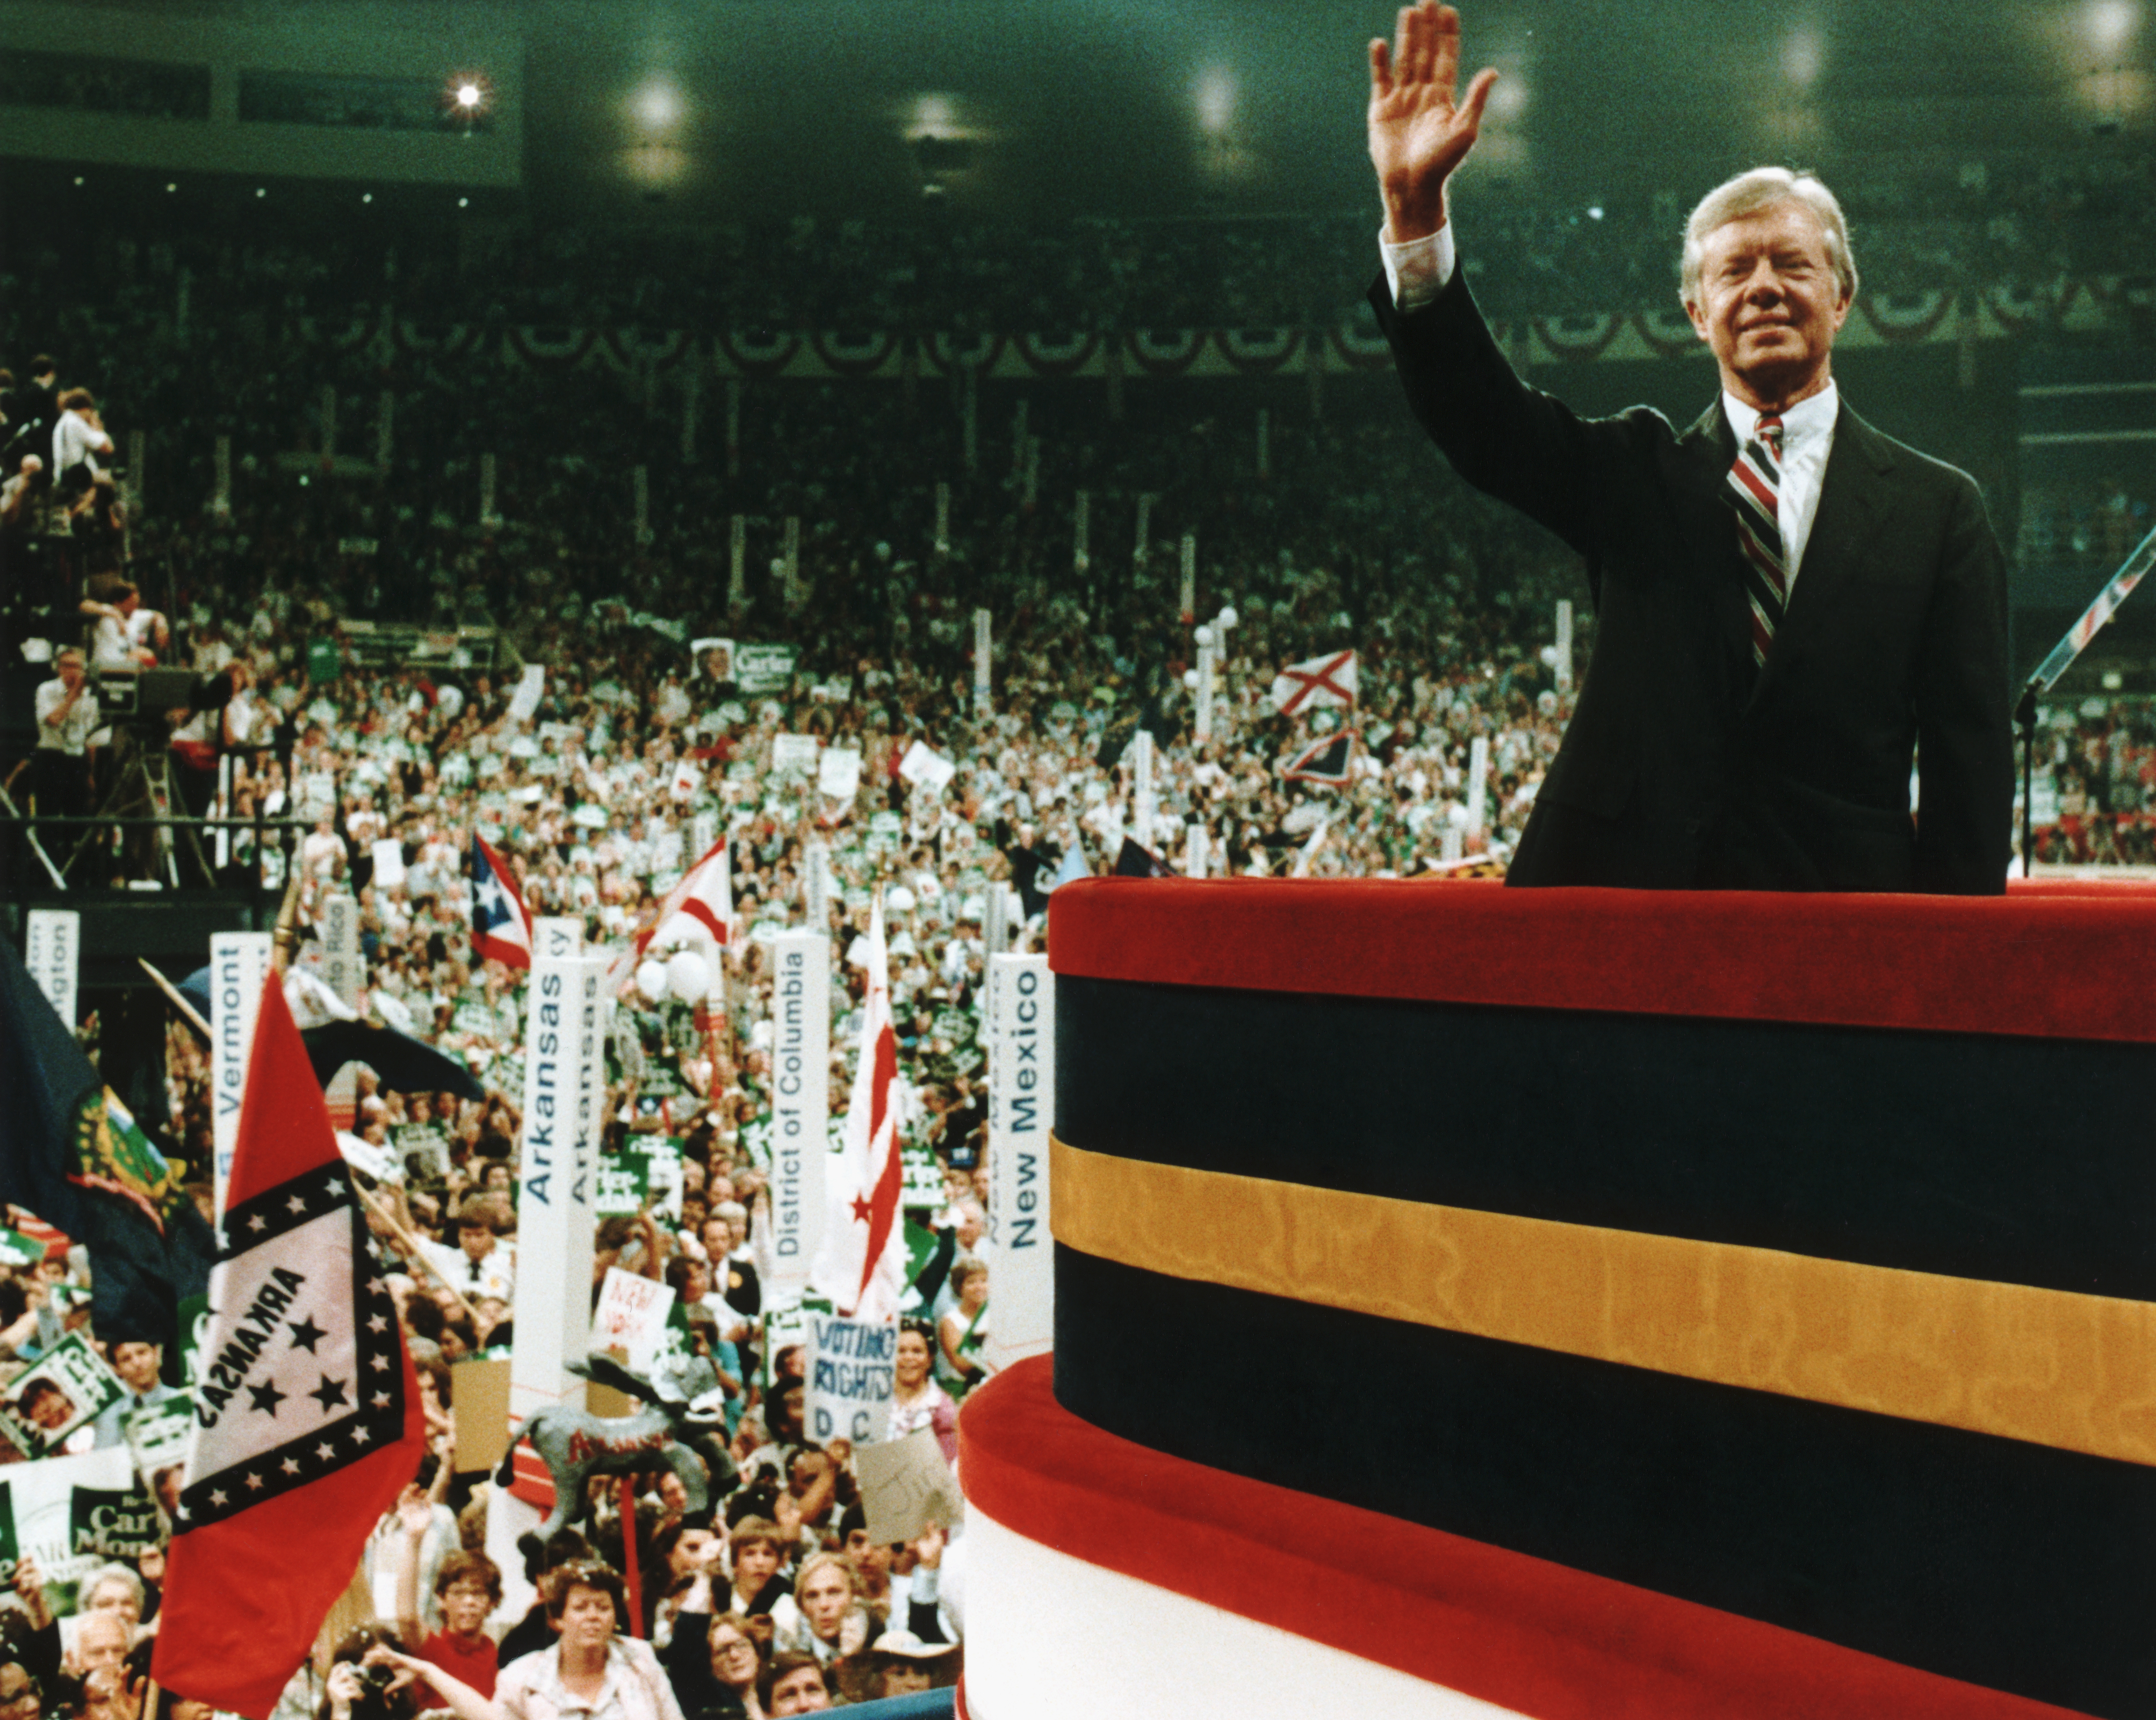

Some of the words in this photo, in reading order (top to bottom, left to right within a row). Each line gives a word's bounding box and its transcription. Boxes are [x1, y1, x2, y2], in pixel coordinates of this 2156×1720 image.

[219, 947, 241, 1116] Vermont
[779, 951, 804, 1095] Columbia
[1010, 970, 1039, 1133] Mexico
[527, 973, 562, 1205] Arkansas
[572, 975, 597, 1204] Arkansas
[780, 1108, 802, 1137] of
[777, 1147, 801, 1258] District
[1010, 1153, 1039, 1250] New
[814, 1318, 897, 1360] VOTING
[814, 1406, 833, 1438] D
